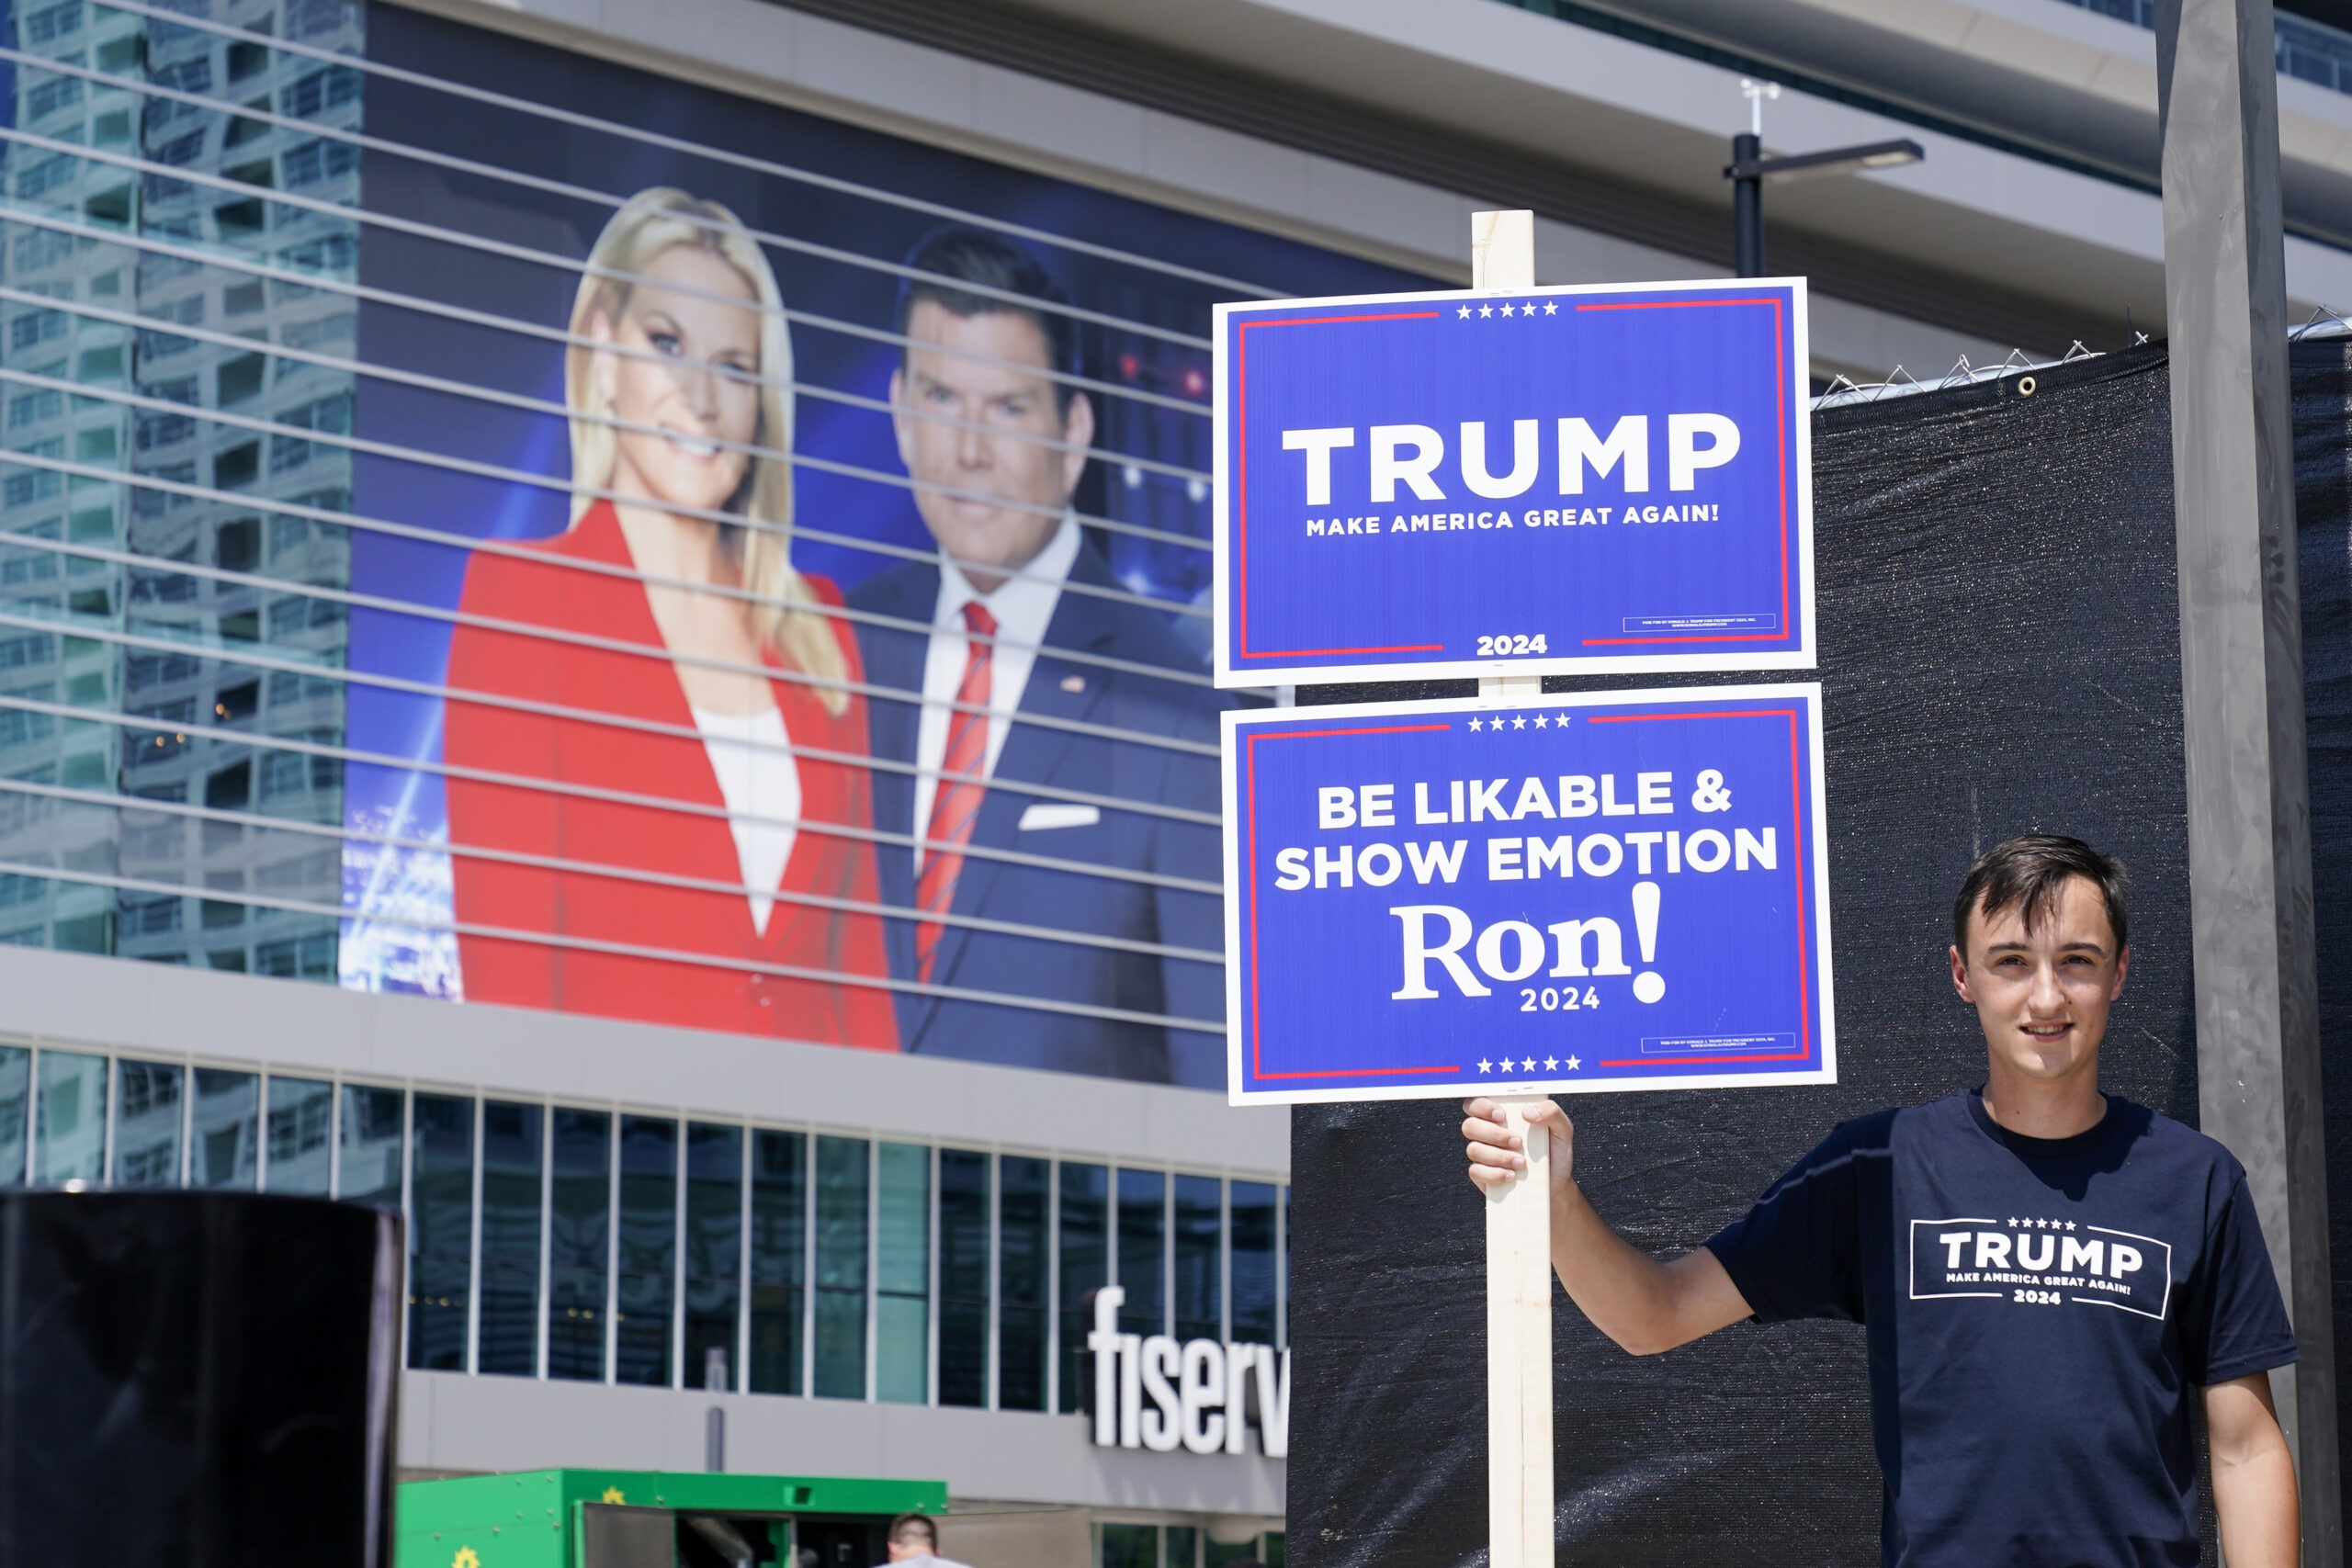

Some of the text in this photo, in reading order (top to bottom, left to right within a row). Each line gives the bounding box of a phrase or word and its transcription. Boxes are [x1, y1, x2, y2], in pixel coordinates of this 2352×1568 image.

[1282, 412, 1741, 506] TRUMP
[1306, 503, 1719, 537] MAKE AMERICA GREAT AGAIN!
[1476, 634, 1547, 657] 2024
[1317, 768, 1733, 829] BE LIKABLE &
[1274, 827, 1778, 891] SHOW EMOTION
[1389, 880, 1666, 1004] Ron!
[1520, 986, 1600, 1012] 2024
[1939, 1231, 2143, 1280] TRUMP
[1946, 1272, 2132, 1296] MAKE AMERICA GREAT AGAIN!
[2013, 1289, 2062, 1305] 2024
[1089, 1285, 1290, 1458] fiserv
